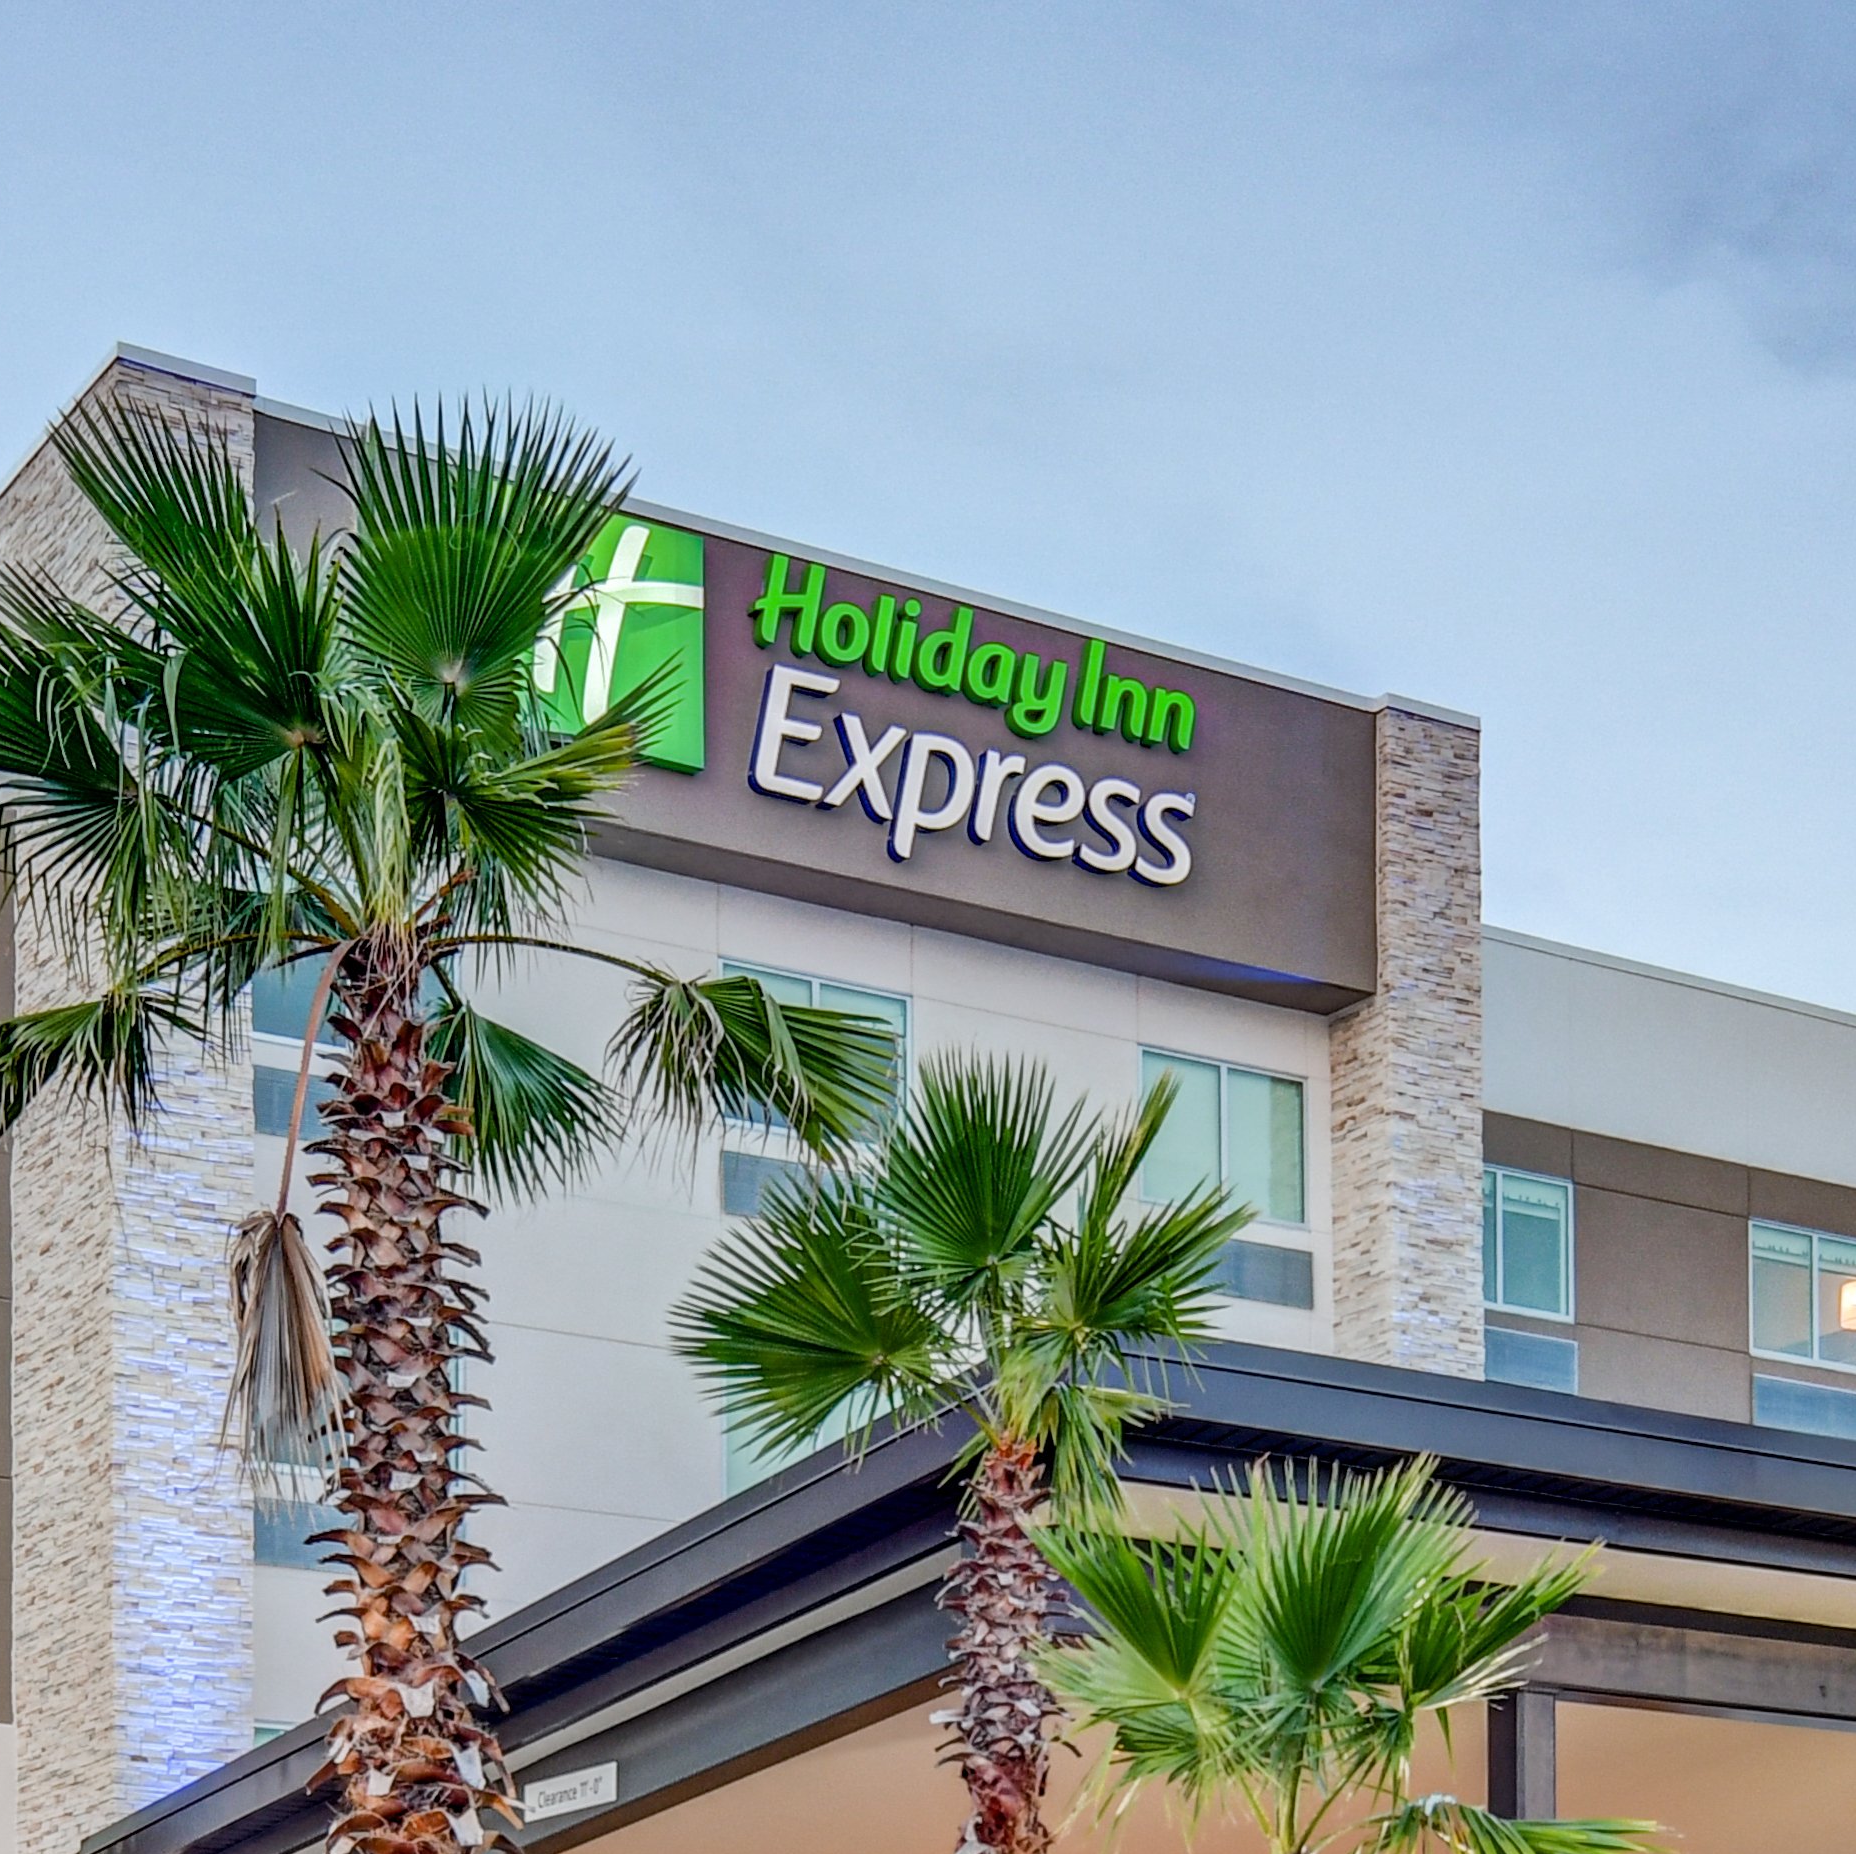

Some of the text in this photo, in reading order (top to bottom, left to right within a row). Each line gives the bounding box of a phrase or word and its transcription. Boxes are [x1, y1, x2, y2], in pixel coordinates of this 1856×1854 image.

[754, 553, 1197, 753] Holiday Inn
[749, 664, 1195, 887] Express
[538, 1787, 577, 1808] Clearance
